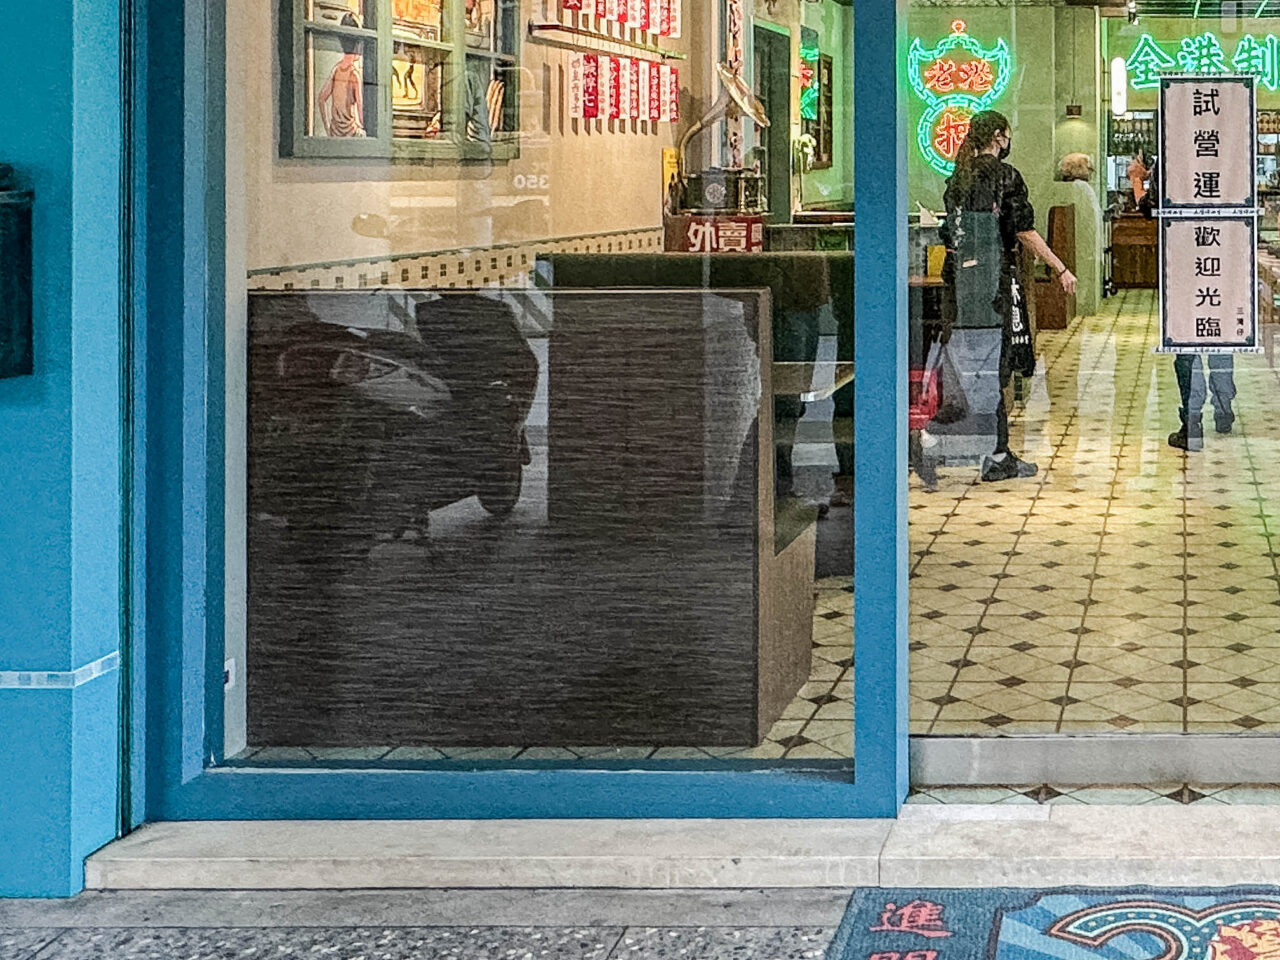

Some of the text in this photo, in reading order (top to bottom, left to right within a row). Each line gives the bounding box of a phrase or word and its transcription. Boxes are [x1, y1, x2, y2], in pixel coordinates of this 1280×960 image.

[1193, 89, 1221, 199] 試營運
[1194, 226, 1222, 338] 歡迎光臨
